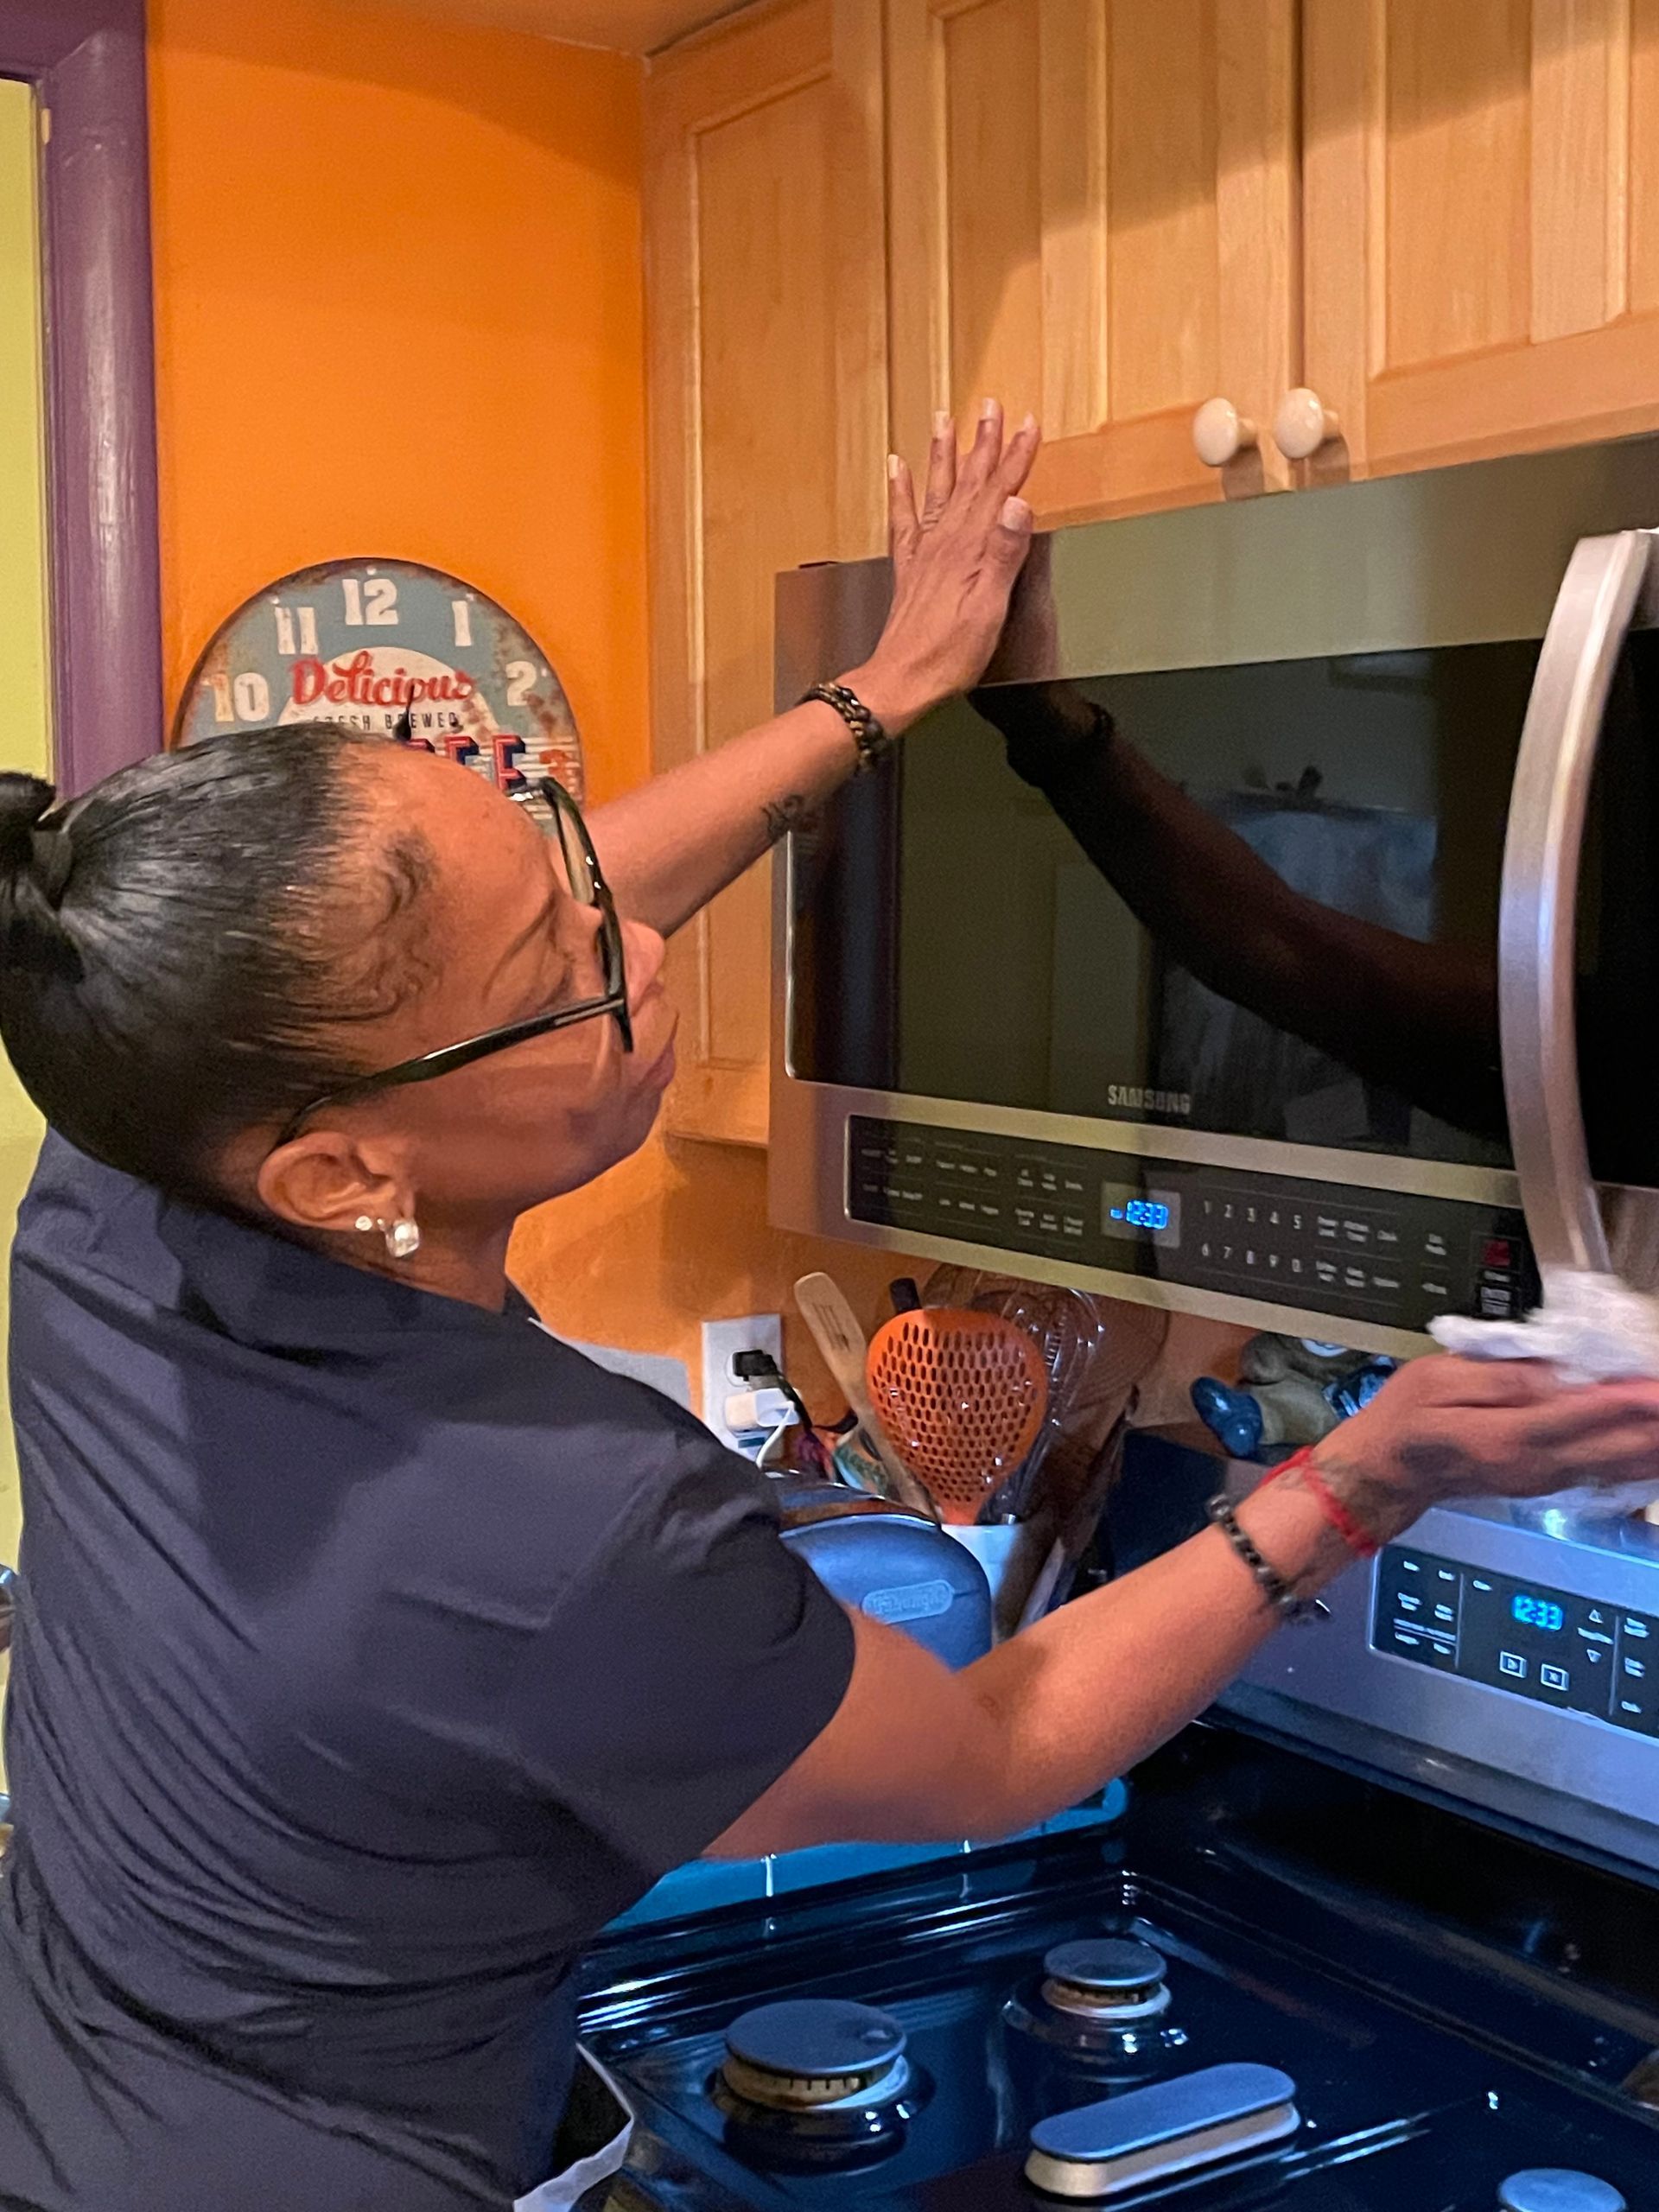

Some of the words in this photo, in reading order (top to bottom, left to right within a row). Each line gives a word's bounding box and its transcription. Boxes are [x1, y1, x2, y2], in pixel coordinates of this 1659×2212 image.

[342, 578, 398, 626] 12
[452, 600, 474, 646] 1
[274, 607, 319, 655] 11
[209, 671, 270, 722] 10
[289, 650, 477, 706] Delicious
[505, 660, 537, 707] 2
[1108, 1084, 1191, 1115] SAMSUNG
[1293, 1215, 1301, 1230] 5
